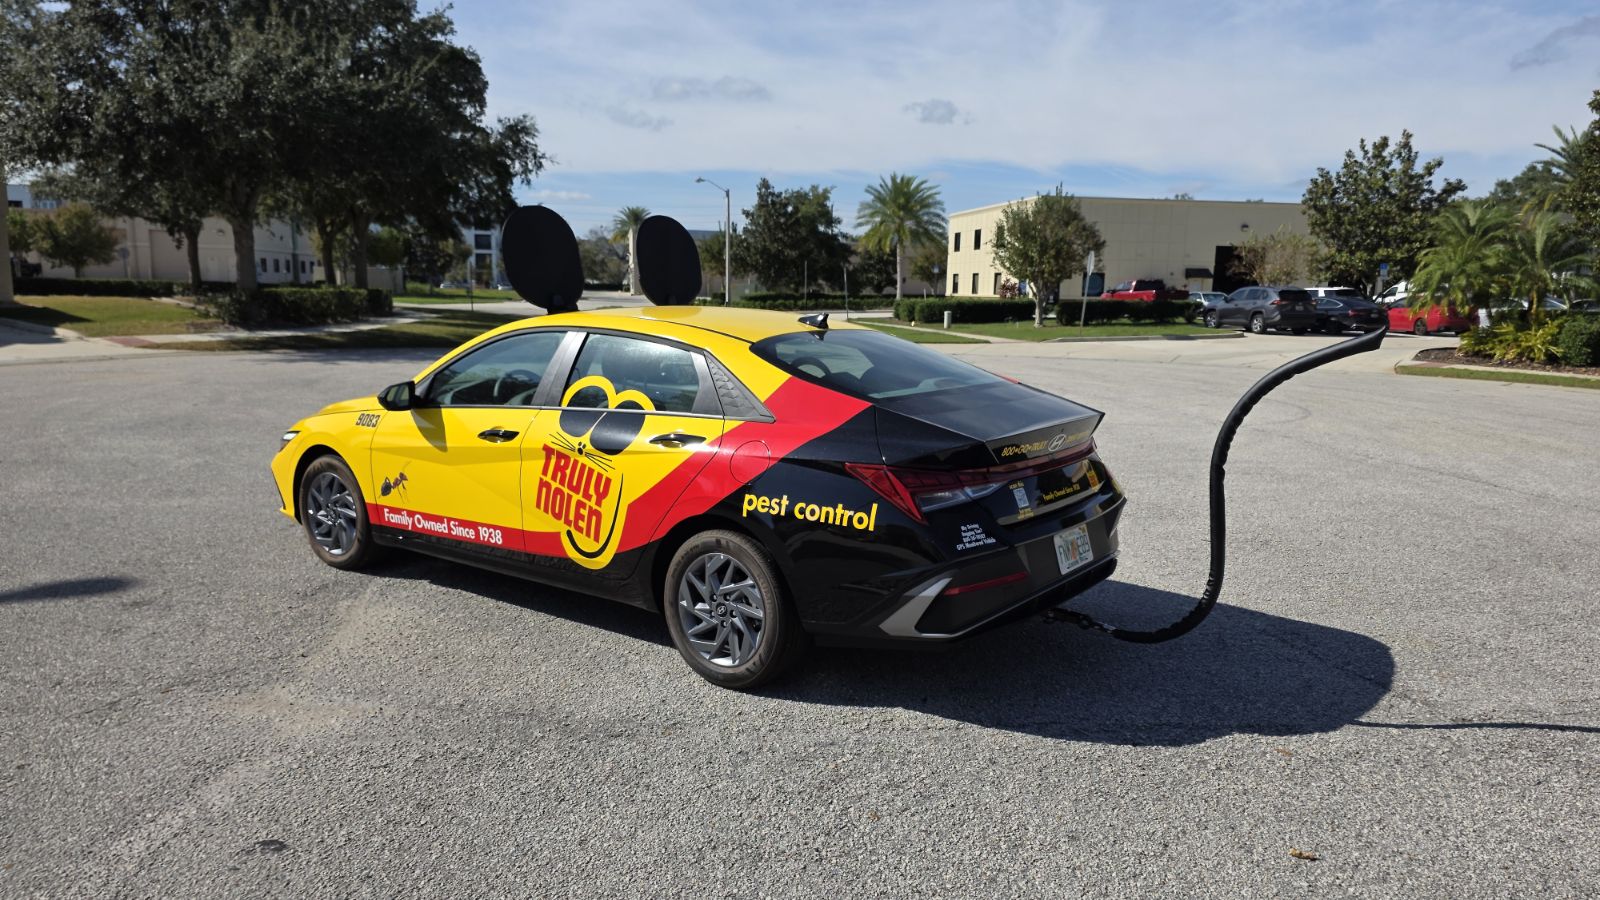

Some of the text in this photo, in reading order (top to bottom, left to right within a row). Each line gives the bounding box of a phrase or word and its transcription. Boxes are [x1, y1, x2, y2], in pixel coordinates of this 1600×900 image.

[356, 413, 380, 428] 9083
[542, 443, 612, 509] TRULY
[383, 508, 503, 545] Family Owned Since 1938
[536, 477, 603, 544] NOLEN
[742, 493, 878, 531] pest control
